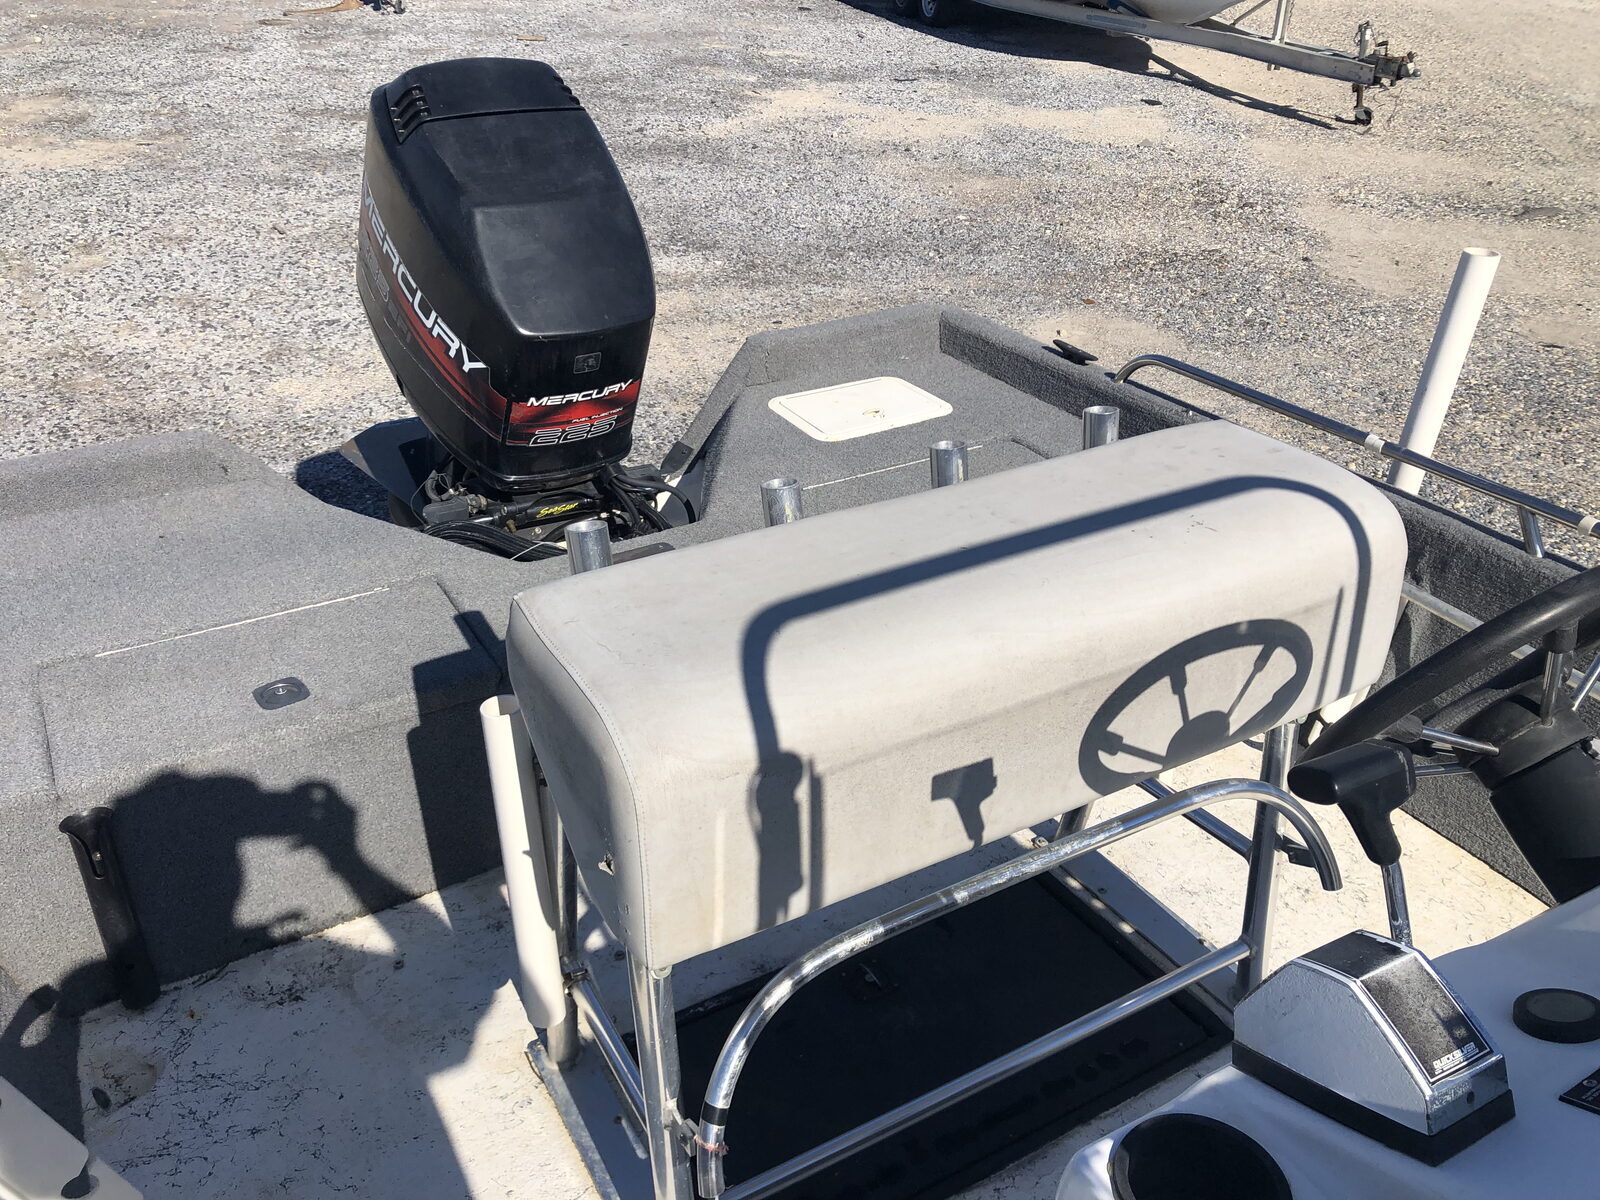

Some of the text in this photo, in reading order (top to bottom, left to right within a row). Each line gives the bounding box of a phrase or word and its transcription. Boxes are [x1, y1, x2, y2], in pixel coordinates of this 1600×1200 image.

[364, 177, 487, 373] MERCURY
[527, 379, 633, 407] MERCURY
[591, 407, 624, 419] INJECTION
[528, 415, 618, 447] 225
[536, 502, 579, 518] SeaStar
[1433, 1041, 1476, 1069] QUICKSILVER
